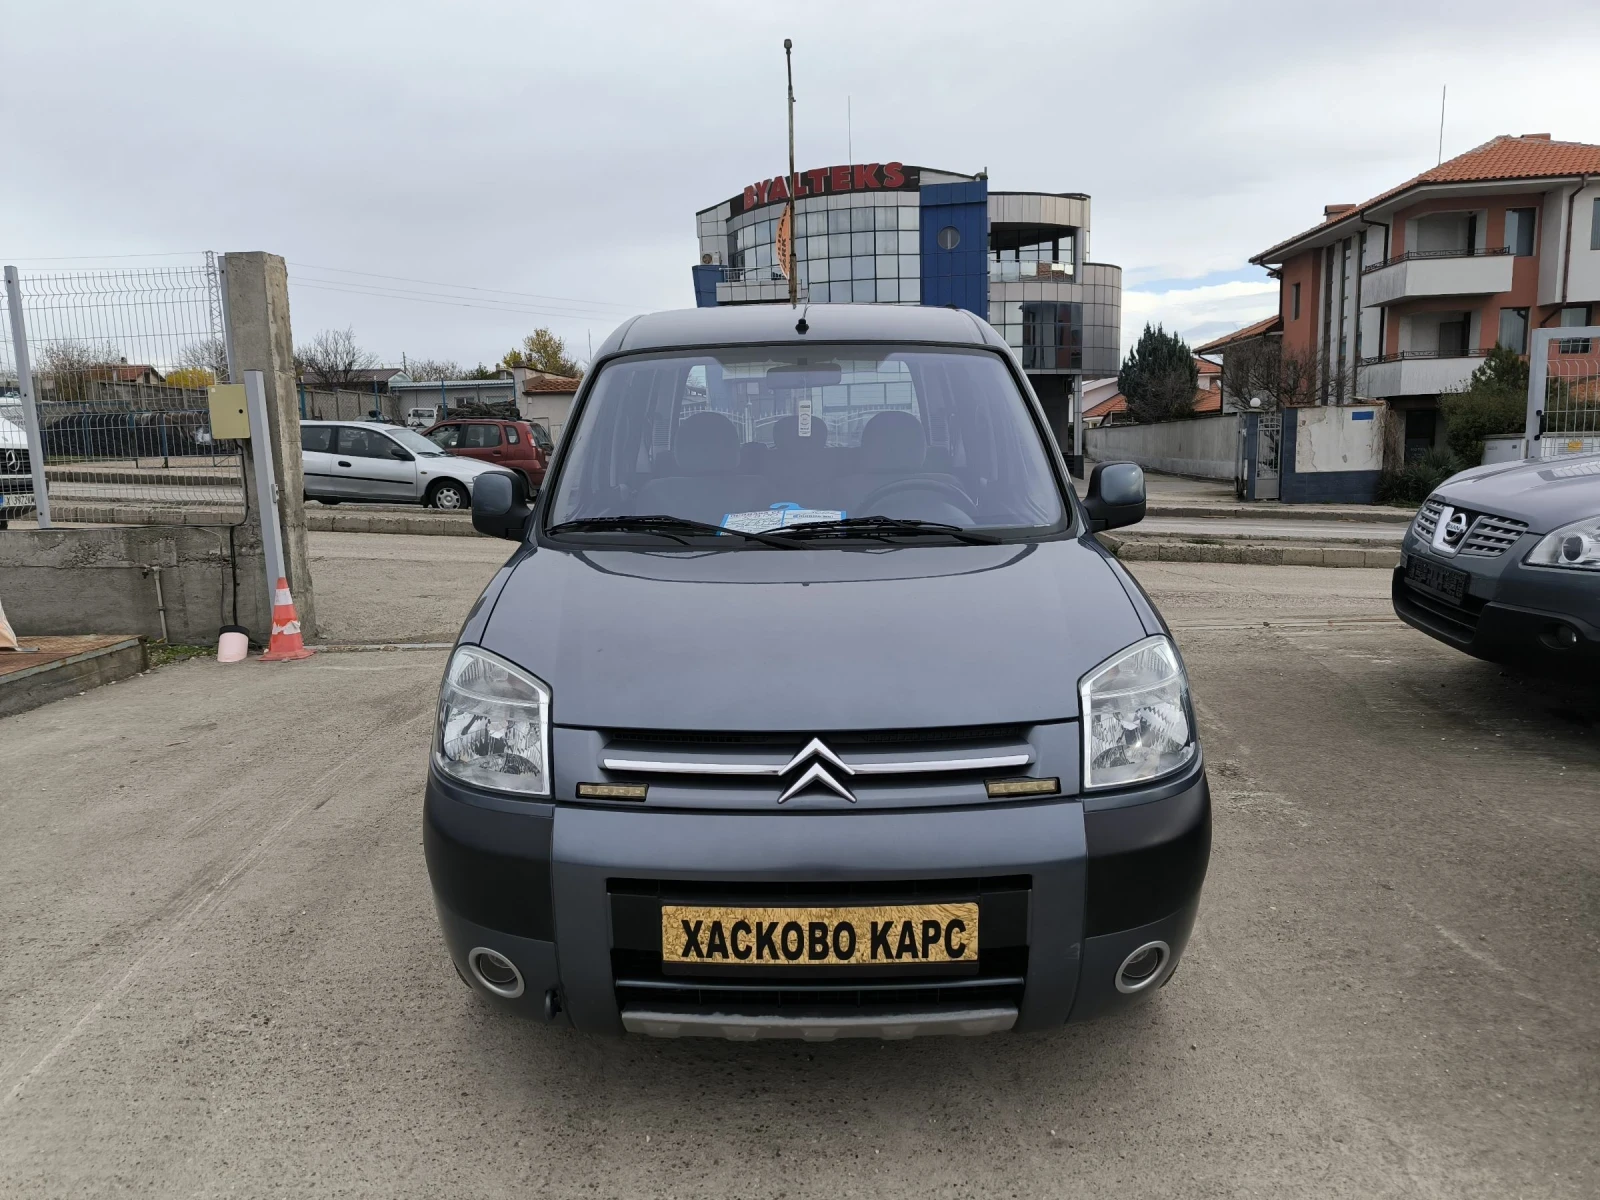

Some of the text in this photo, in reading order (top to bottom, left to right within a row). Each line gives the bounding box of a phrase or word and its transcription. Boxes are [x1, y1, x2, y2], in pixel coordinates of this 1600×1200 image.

[744, 162, 905, 210] BYALTEKS
[681, 919, 967, 961] ХАСКОВО КАРС
